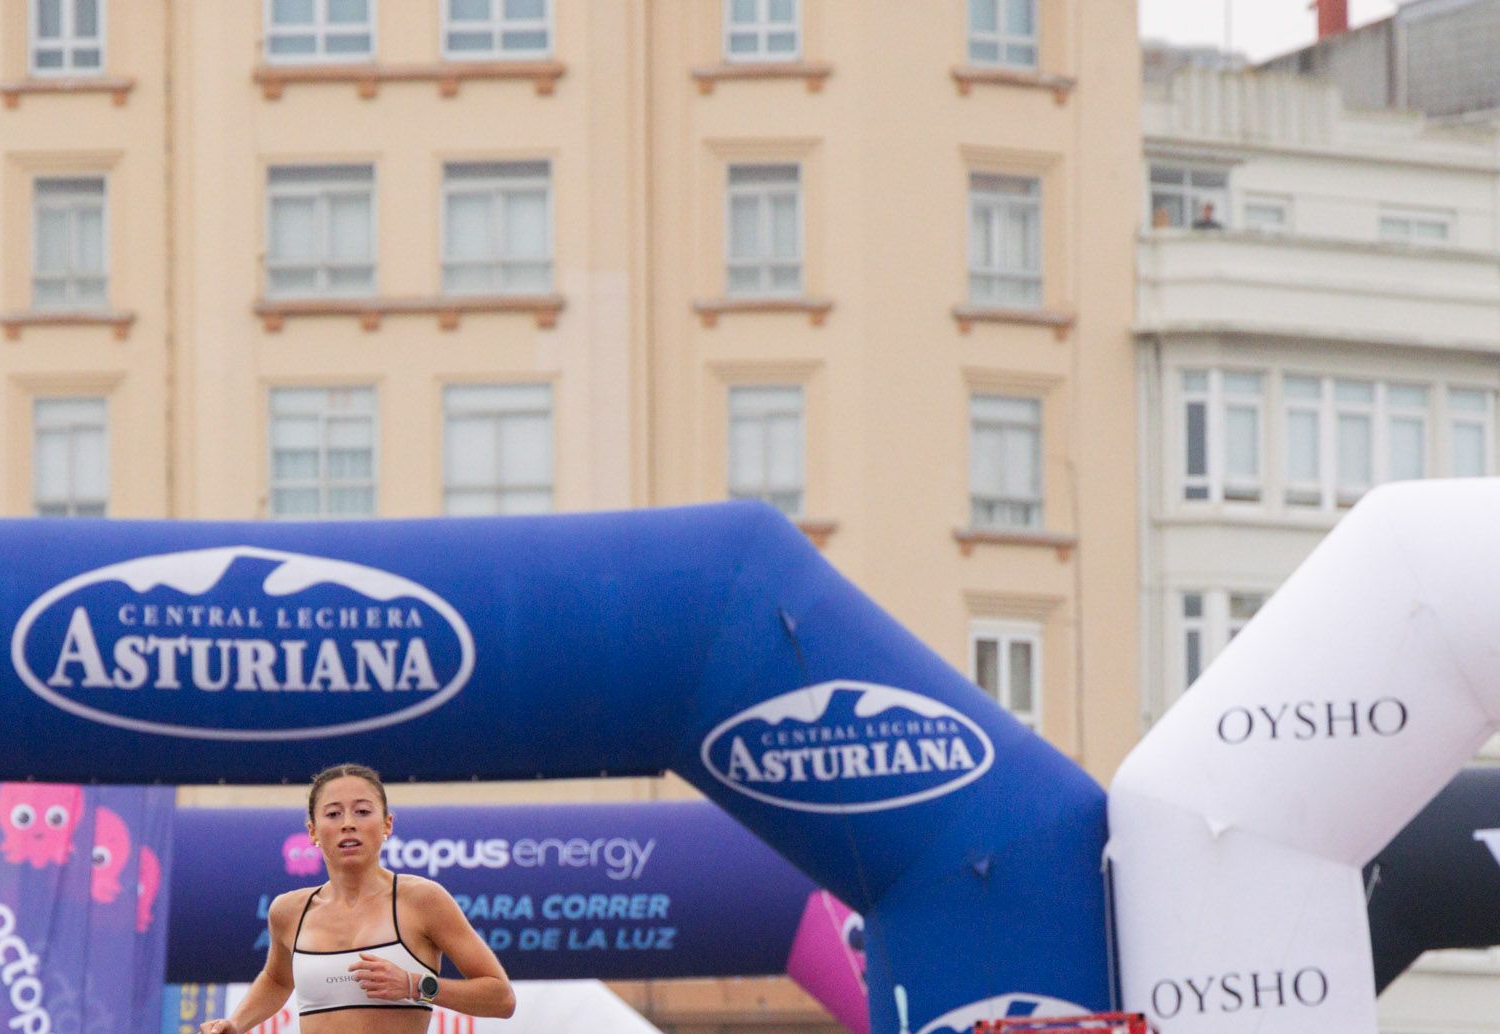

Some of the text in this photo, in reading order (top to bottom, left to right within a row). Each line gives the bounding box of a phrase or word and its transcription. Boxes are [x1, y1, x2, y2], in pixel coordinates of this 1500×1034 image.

[118, 604, 424, 630] CENTRAL LECHERA
[47, 606, 440, 692] ASTURIANA
[761, 718, 960, 746] CENTRAL LECHERA
[1216, 697, 1409, 744] OYSHO
[728, 735, 976, 783] ASTURIANA
[381, 836, 656, 880] topus energy
[541, 893, 671, 920] CORRER
[518, 927, 561, 951] DE
[567, 927, 608, 951] LA
[616, 927, 677, 951] LUZ
[1152, 966, 1330, 1019] OYSHO
